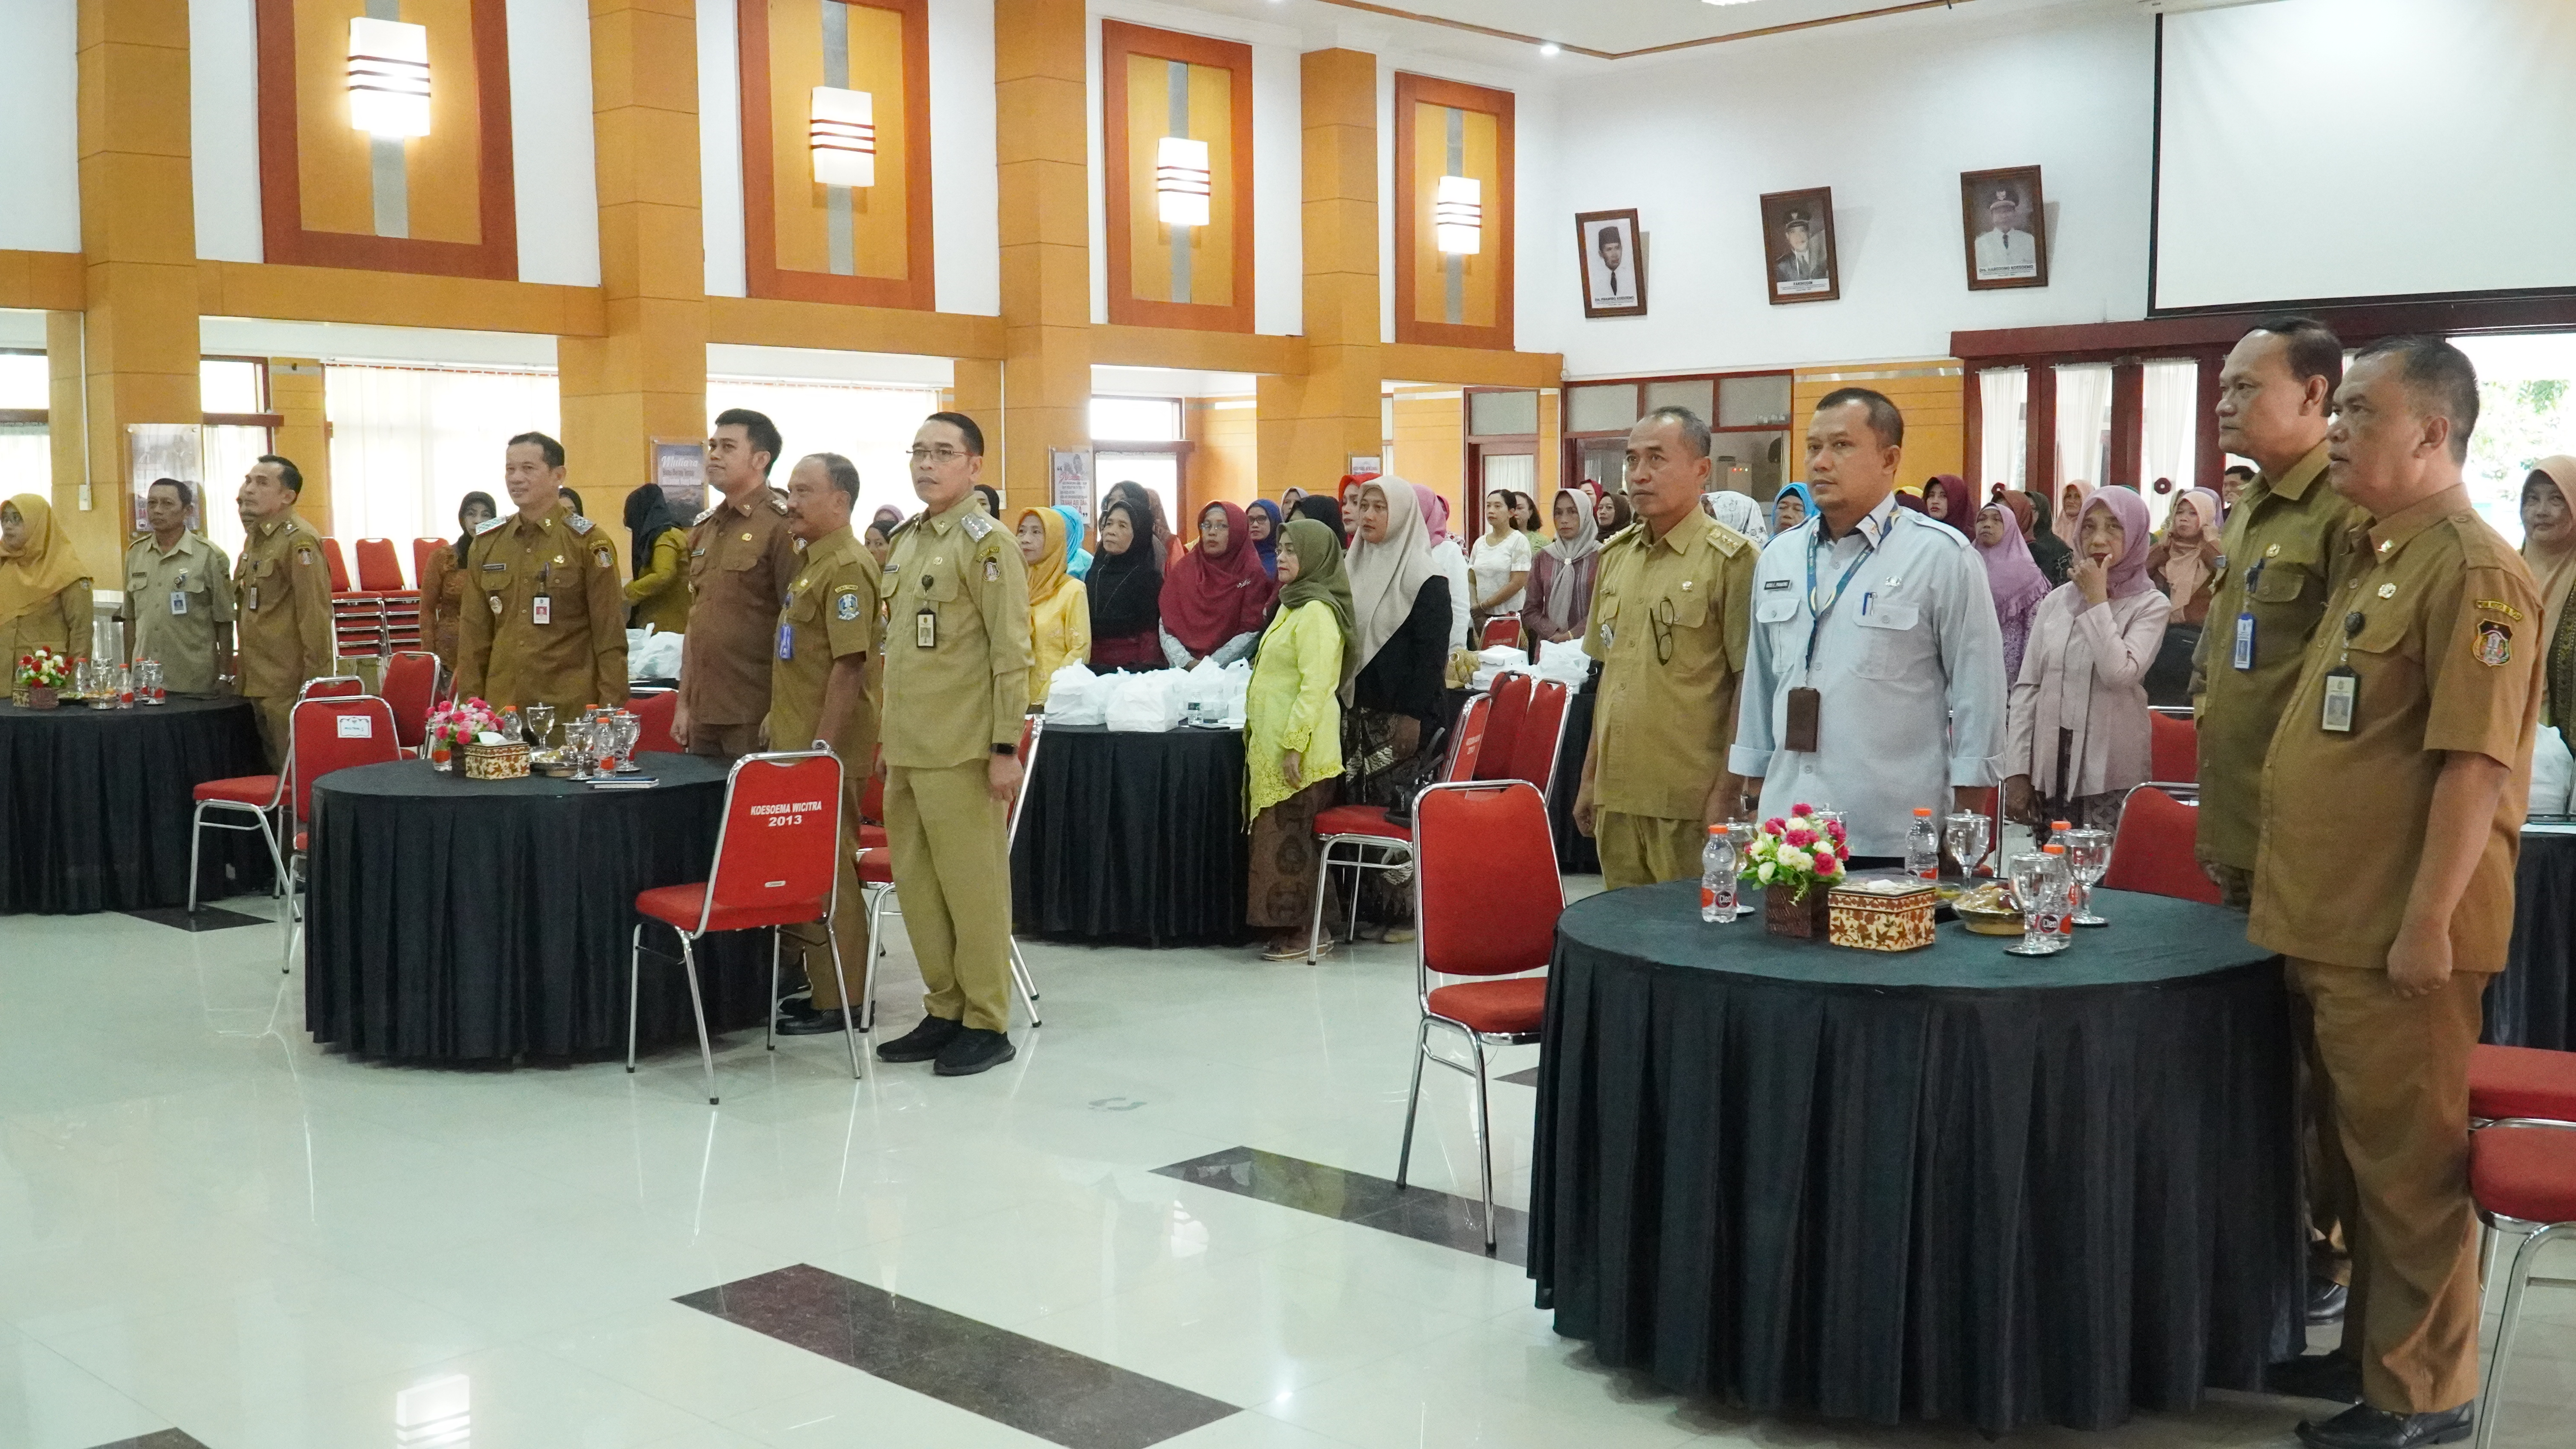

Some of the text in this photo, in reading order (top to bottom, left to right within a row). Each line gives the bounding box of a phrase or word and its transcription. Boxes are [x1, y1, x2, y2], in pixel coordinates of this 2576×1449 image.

[661, 455, 699, 467] Mutiara
[750, 801, 822, 815] KOESOEMA WICITRA
[768, 815, 802, 827] 2013
[1719, 894, 1731, 903] Cleo
